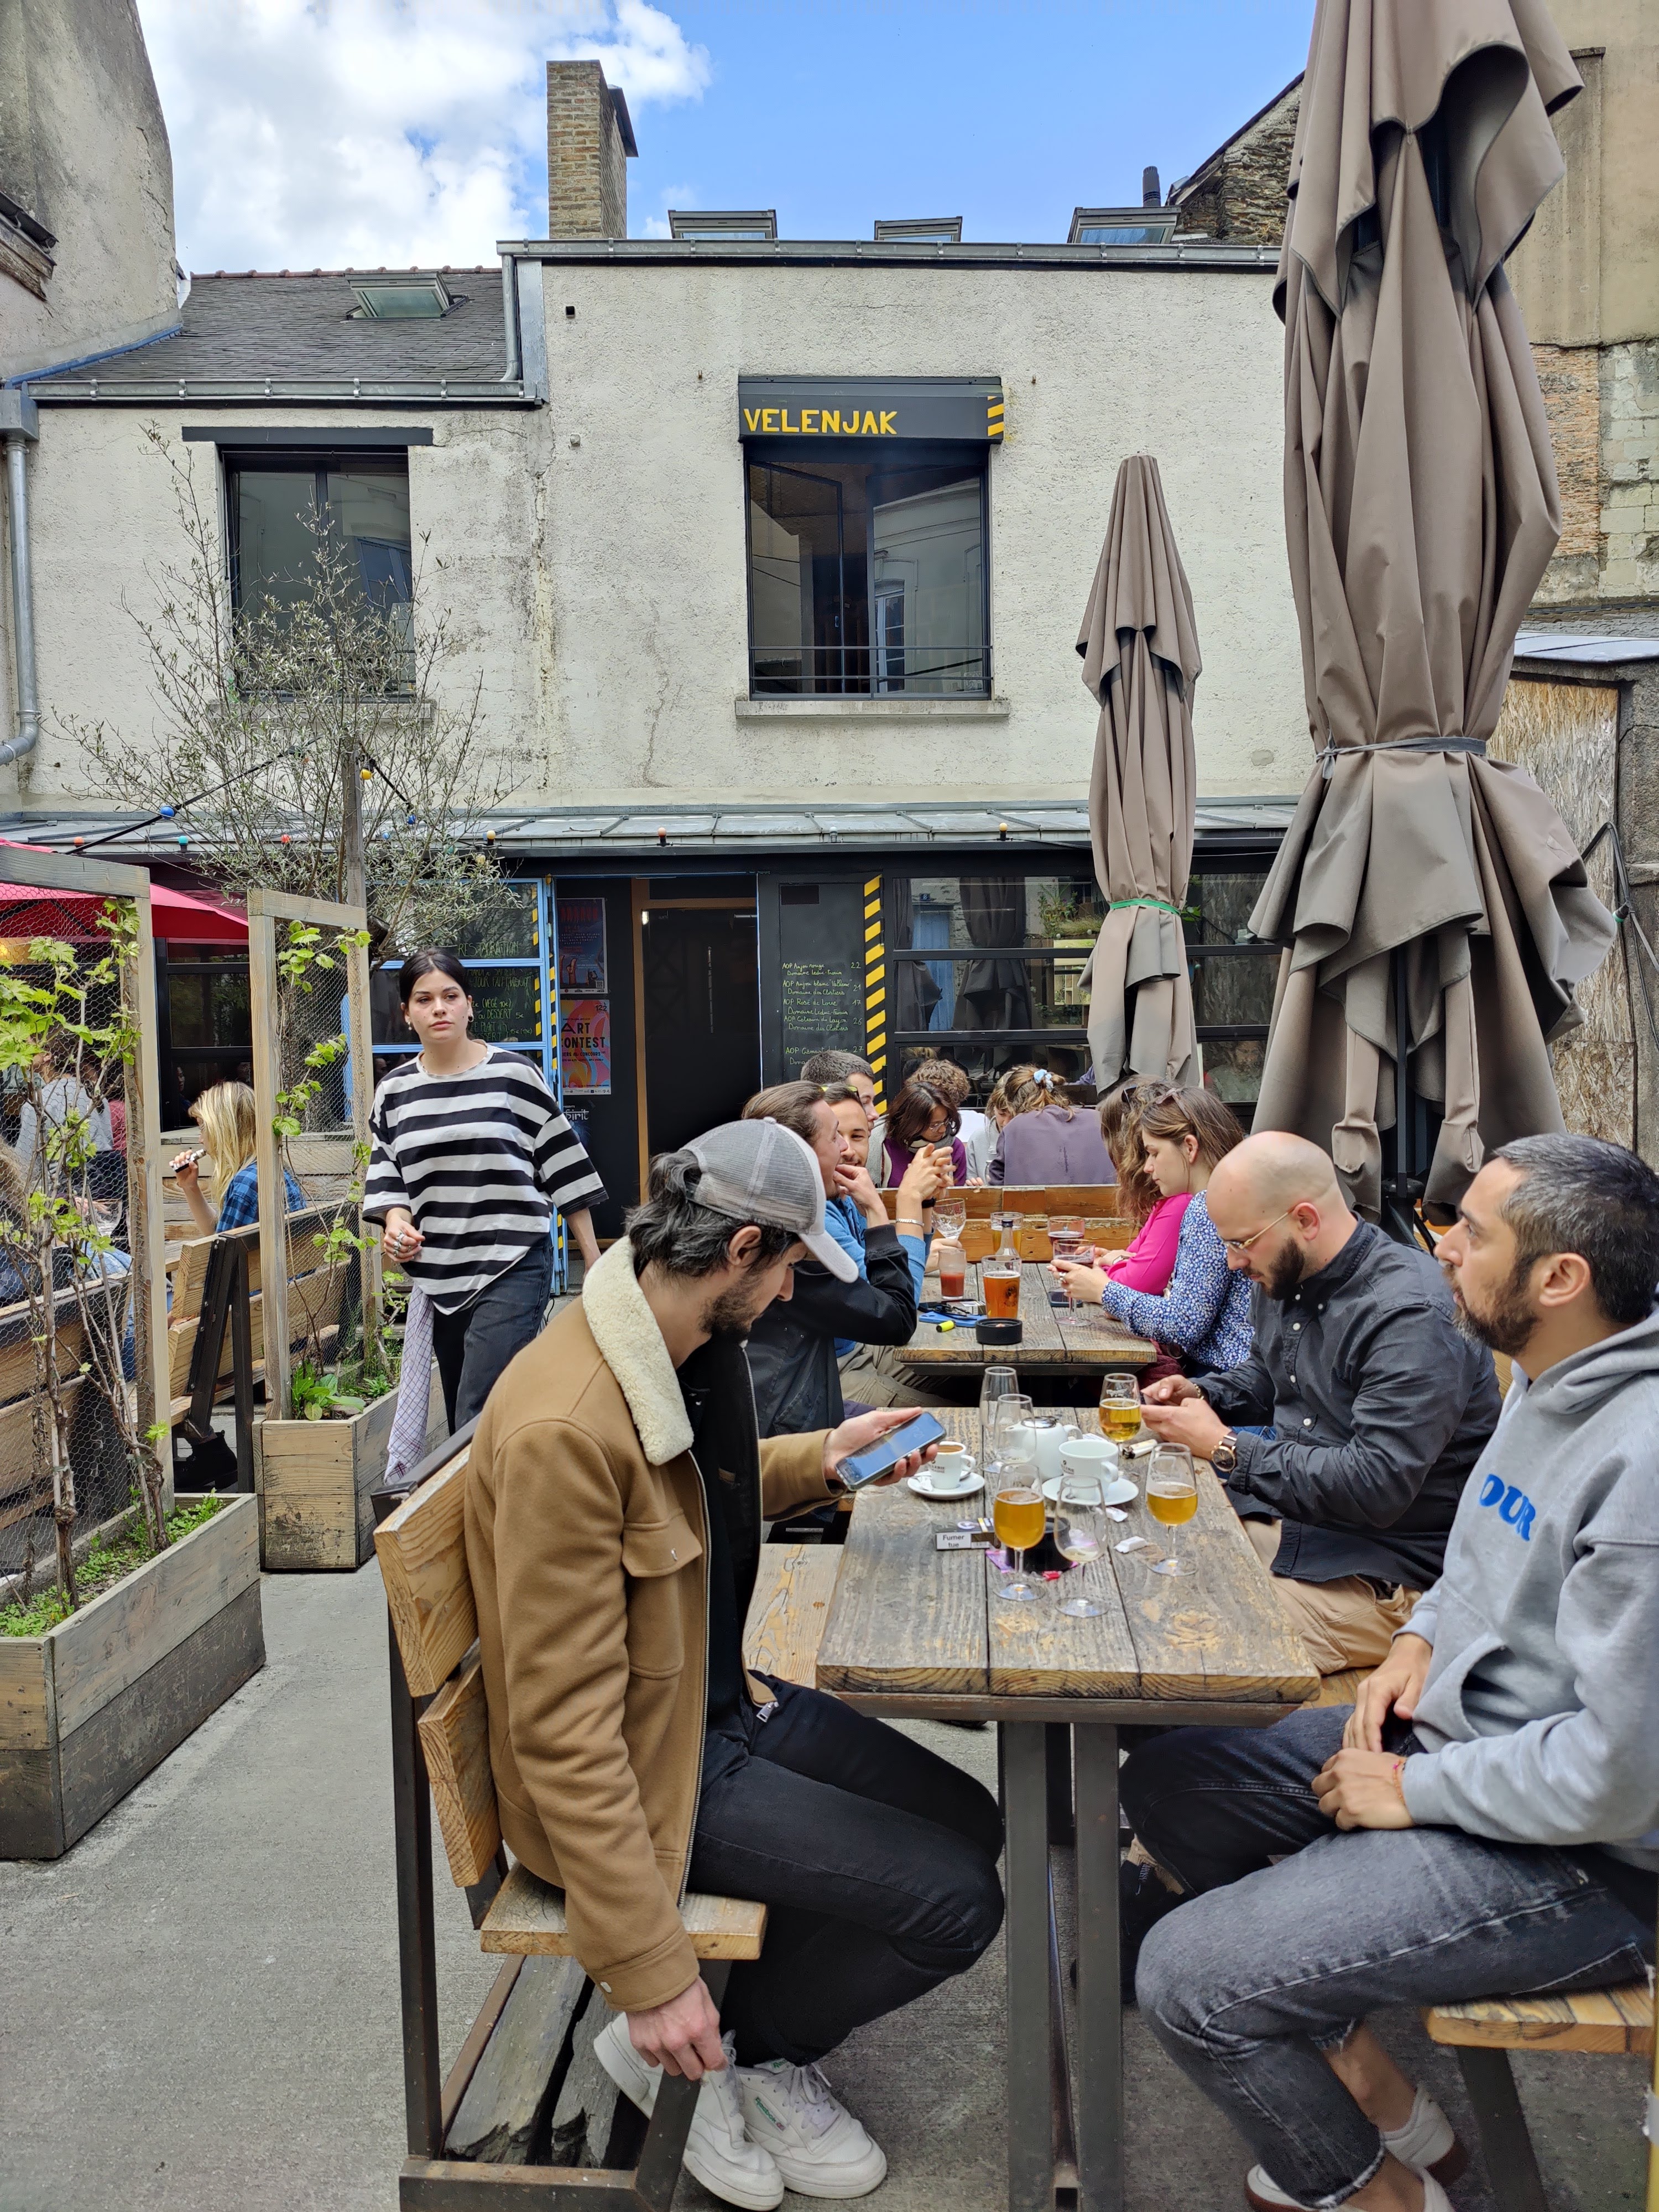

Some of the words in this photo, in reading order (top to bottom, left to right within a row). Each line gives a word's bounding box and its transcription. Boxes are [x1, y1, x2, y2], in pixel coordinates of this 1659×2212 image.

[743, 408, 898, 435] VELENJAK
[794, 963, 808, 972] Anjou
[796, 981, 812, 989] Anjou
[487, 1009, 512, 1019] DESSERT
[561, 1022, 590, 1034] ART
[561, 1037, 605, 1048] ONTEST
